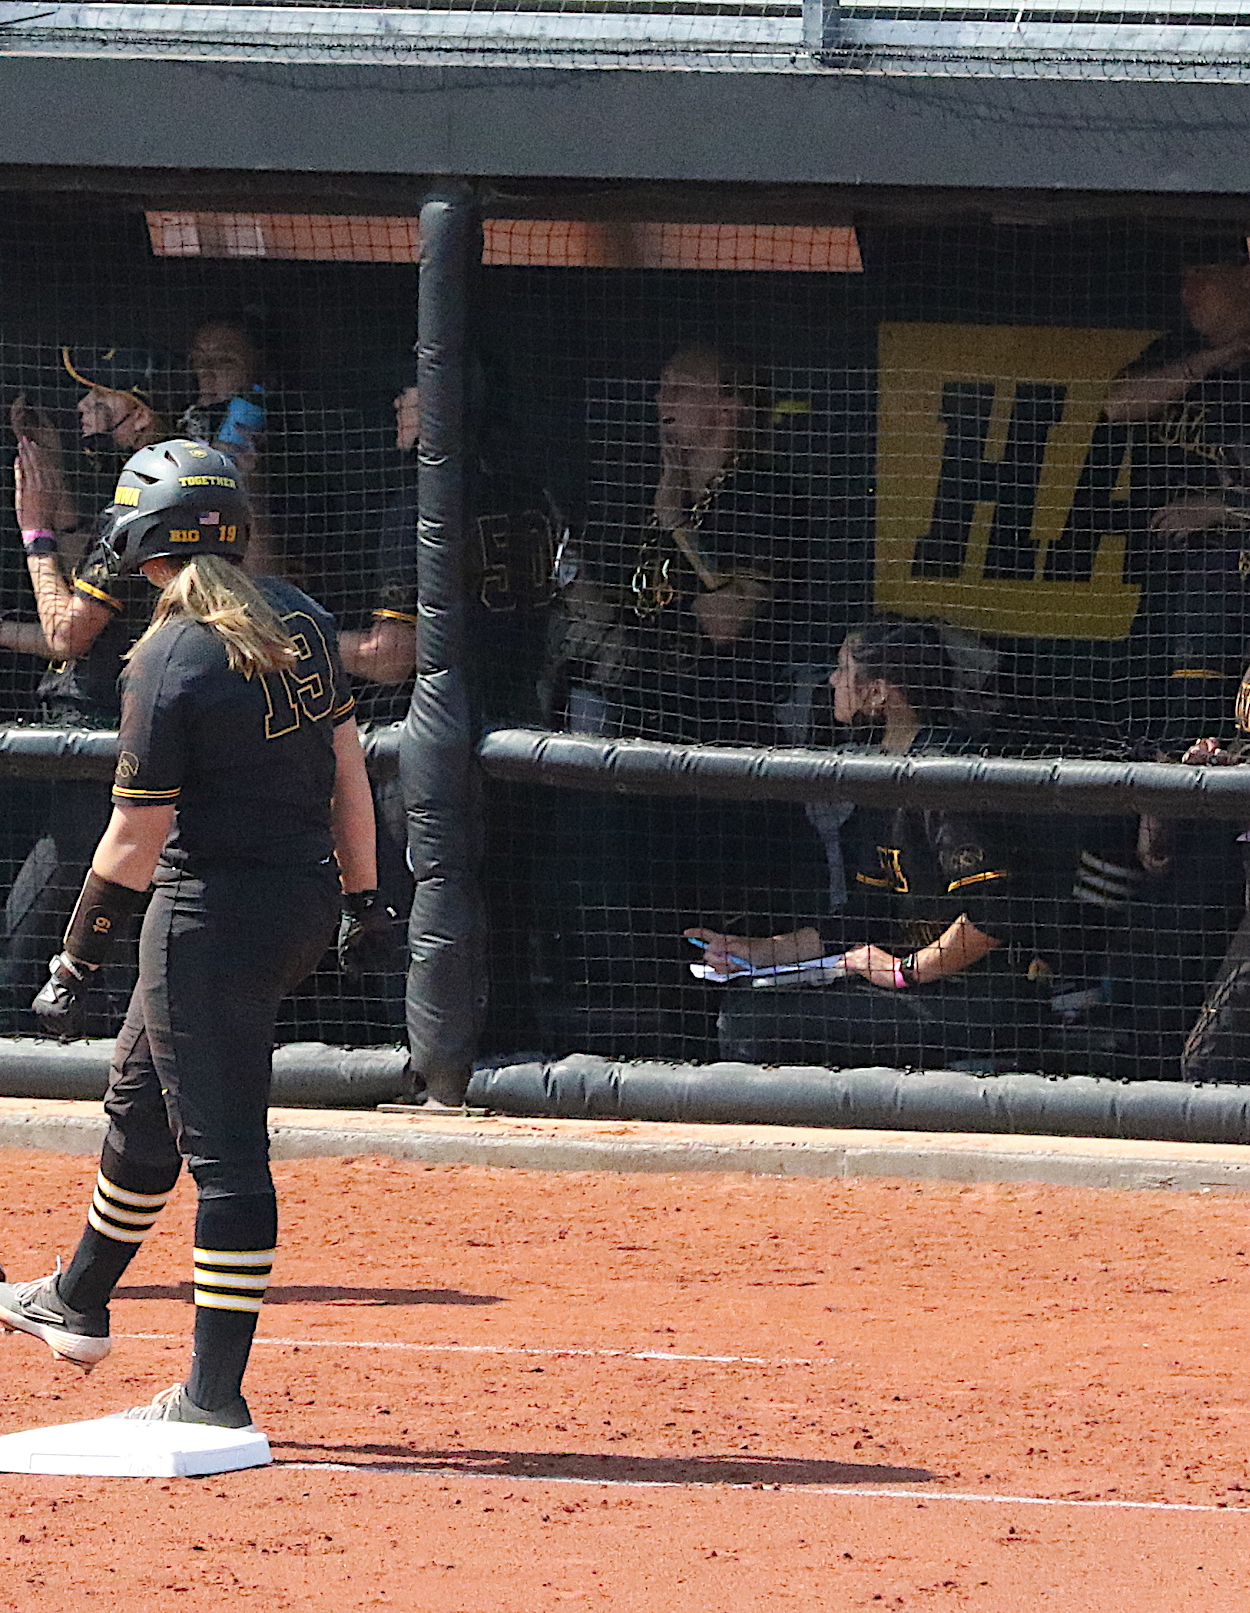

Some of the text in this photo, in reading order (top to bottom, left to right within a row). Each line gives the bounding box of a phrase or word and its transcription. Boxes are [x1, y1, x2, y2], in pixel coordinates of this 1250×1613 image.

[178, 475, 238, 490] TOGETHER
[218, 525, 238, 543] 19
[259, 609, 336, 739] 19
